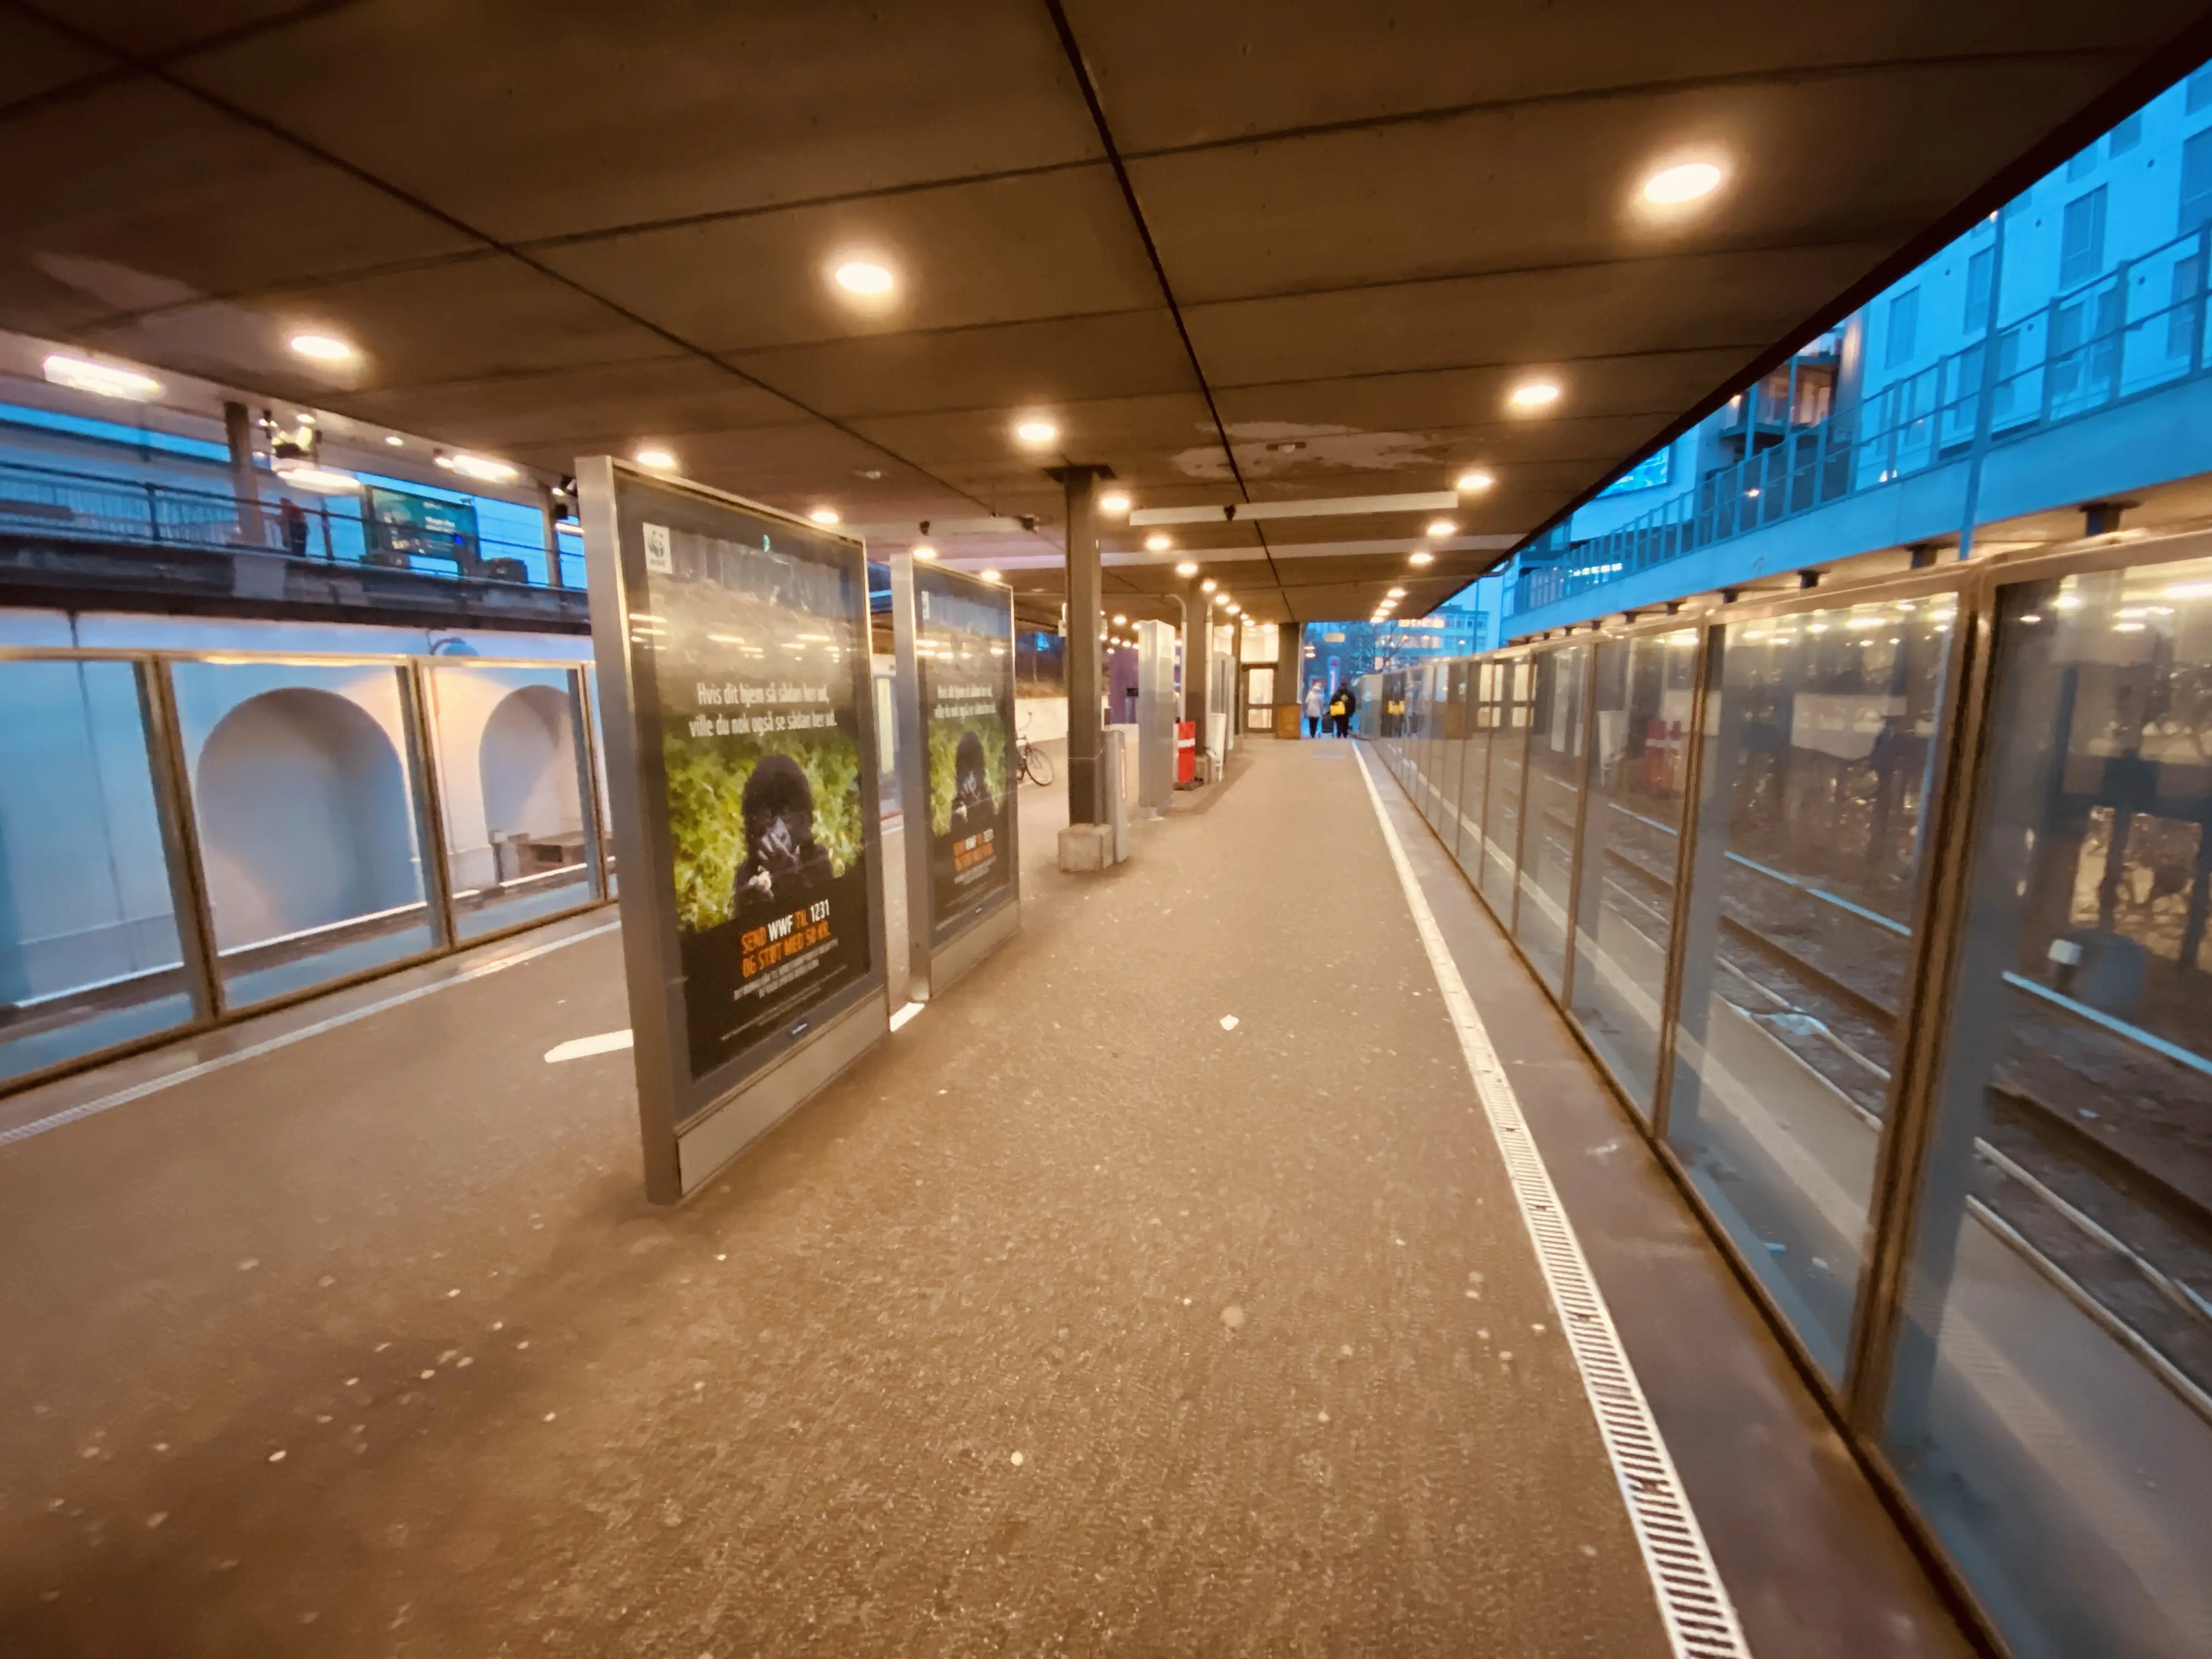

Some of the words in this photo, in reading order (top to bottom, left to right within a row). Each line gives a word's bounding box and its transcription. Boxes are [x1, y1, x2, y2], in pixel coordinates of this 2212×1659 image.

[697, 682, 722, 705] Hvis
[724, 682, 740, 704] dit
[689, 714, 714, 737] ville
[716, 713, 730, 735] du
[752, 710, 774, 736] også
[775, 715, 786, 731] se
[741, 926, 766, 955] SEND
[768, 914, 793, 941] WWF
[795, 909, 809, 929] TIL
[810, 899, 830, 922] 1231
[784, 932, 804, 956] MED
